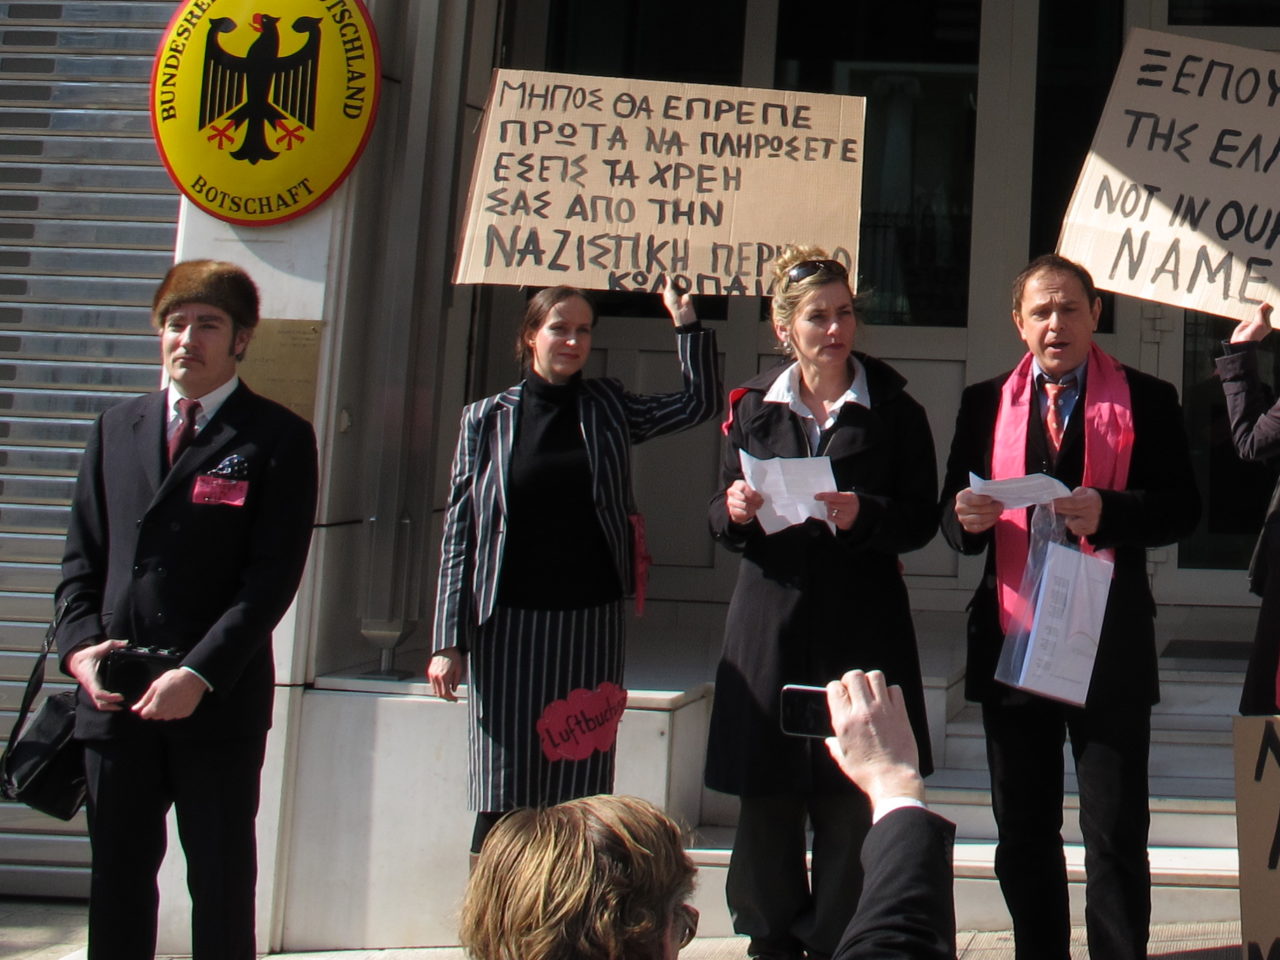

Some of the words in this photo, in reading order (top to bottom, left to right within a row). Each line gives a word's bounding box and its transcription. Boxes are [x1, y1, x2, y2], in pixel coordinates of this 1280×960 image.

[499, 80, 603, 112] ΜΗΠΟΣ
[612, 92, 654, 120] ΘΑ
[662, 95, 812, 129] ΕΠΡΕΠΕ
[645, 126, 689, 157] ΝΑ
[1124, 108, 1200, 164] ΤΗΣ
[190, 174, 315, 216] BOTSCHAFT
[603, 158, 640, 188] ΤΑ
[648, 160, 743, 193] ΧΡΕΗ
[485, 187, 552, 218] ΣΑΣ
[565, 194, 636, 224] ΑΠΟ
[647, 198, 724, 227] ΤΗΝ
[1093, 174, 1162, 222] NOT
[1168, 193, 1212, 231] IN
